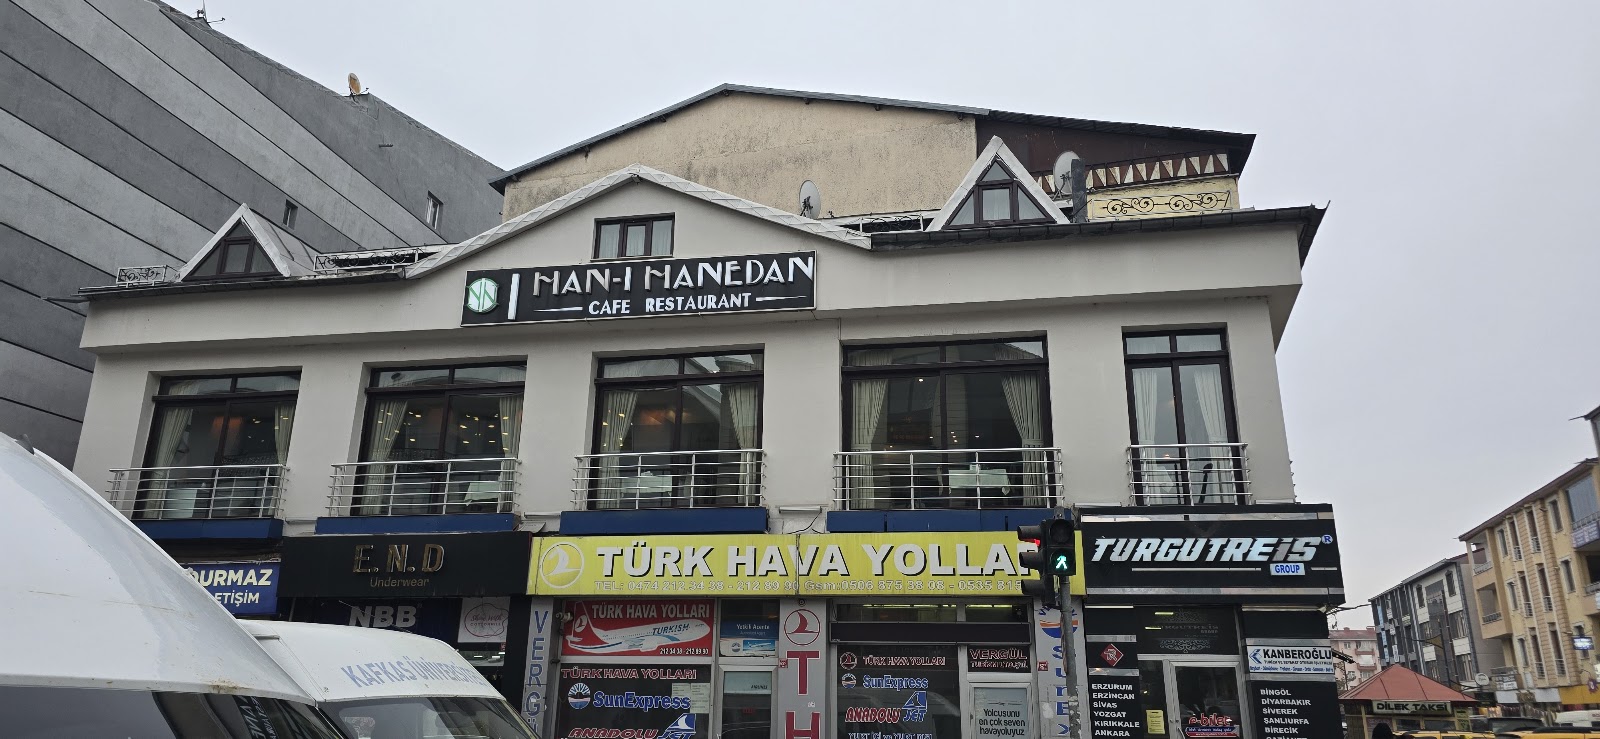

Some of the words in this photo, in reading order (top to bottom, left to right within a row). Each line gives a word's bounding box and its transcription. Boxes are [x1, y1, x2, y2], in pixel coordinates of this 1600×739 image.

[644, 256, 813, 291] HANEDAN
[588, 299, 631, 315] CAFE
[645, 292, 752, 313] RESTAURANT
[597, 541, 715, 577] TÜRK
[727, 545, 850, 577] HAVA
[861, 543, 1039, 577] YOLLA
[1274, 564, 1300, 574] GROUP
[370, 577, 429, 588] Underwear
[594, 581, 624, 591] TEL:
[627, 581, 659, 591] 0474
[662, 581, 687, 591] 212
[736, 581, 761, 591] 212
[763, 581, 780, 591] 89
[878, 580, 903, 591] 875
[958, 580, 993, 591] 0535
[214, 590, 260, 607] ETİŞİM
[349, 605, 417, 628] NBB
[592, 603, 623, 619] TÜRK
[626, 604, 658, 619] HAVA
[661, 604, 710, 618] YOLLARI
[969, 648, 1028, 660] VERGÜL
[1263, 647, 1332, 660] KANBEROĞLU
[863, 655, 887, 666] TÜRK
[909, 656, 946, 666] YOLLARI
[341, 660, 417, 688] KAFKAS
[561, 666, 603, 679] TÜRK
[603, 668, 639, 679] HAVA
[641, 668, 697, 680] YOLLARI
[862, 674, 929, 692] SunExpress
[1092, 683, 1133, 691] ERZURUM
[1092, 692, 1135, 700] ERZİNCAN
[1260, 687, 1291, 696] BİNGÖL
[593, 690, 692, 712] SunExpress
[1093, 701, 1117, 709] SİVAS
[1261, 698, 1311, 706] DİYARBAKIR
[1376, 701, 1409, 711] DİLEK
[1411, 702, 1447, 711] TAKSİ
[845, 706, 901, 724] ANADOLU
[902, 709, 927, 722] JET
[983, 708, 1020, 718] Yolcusunu
[1262, 707, 1298, 715] SİVEREK
[989, 717, 1002, 727] çok
[1003, 719, 1026, 727] seven
[1094, 720, 1140, 728] KIRIKKALE
[1189, 712, 1231, 727] e-bilet
[1263, 717, 1310, 725] ŞANLIURFA
[568, 728, 659, 739] ANADOLU
[979, 726, 1025, 738] havayoluyuz
[1264, 726, 1298, 734] BİRECİK
